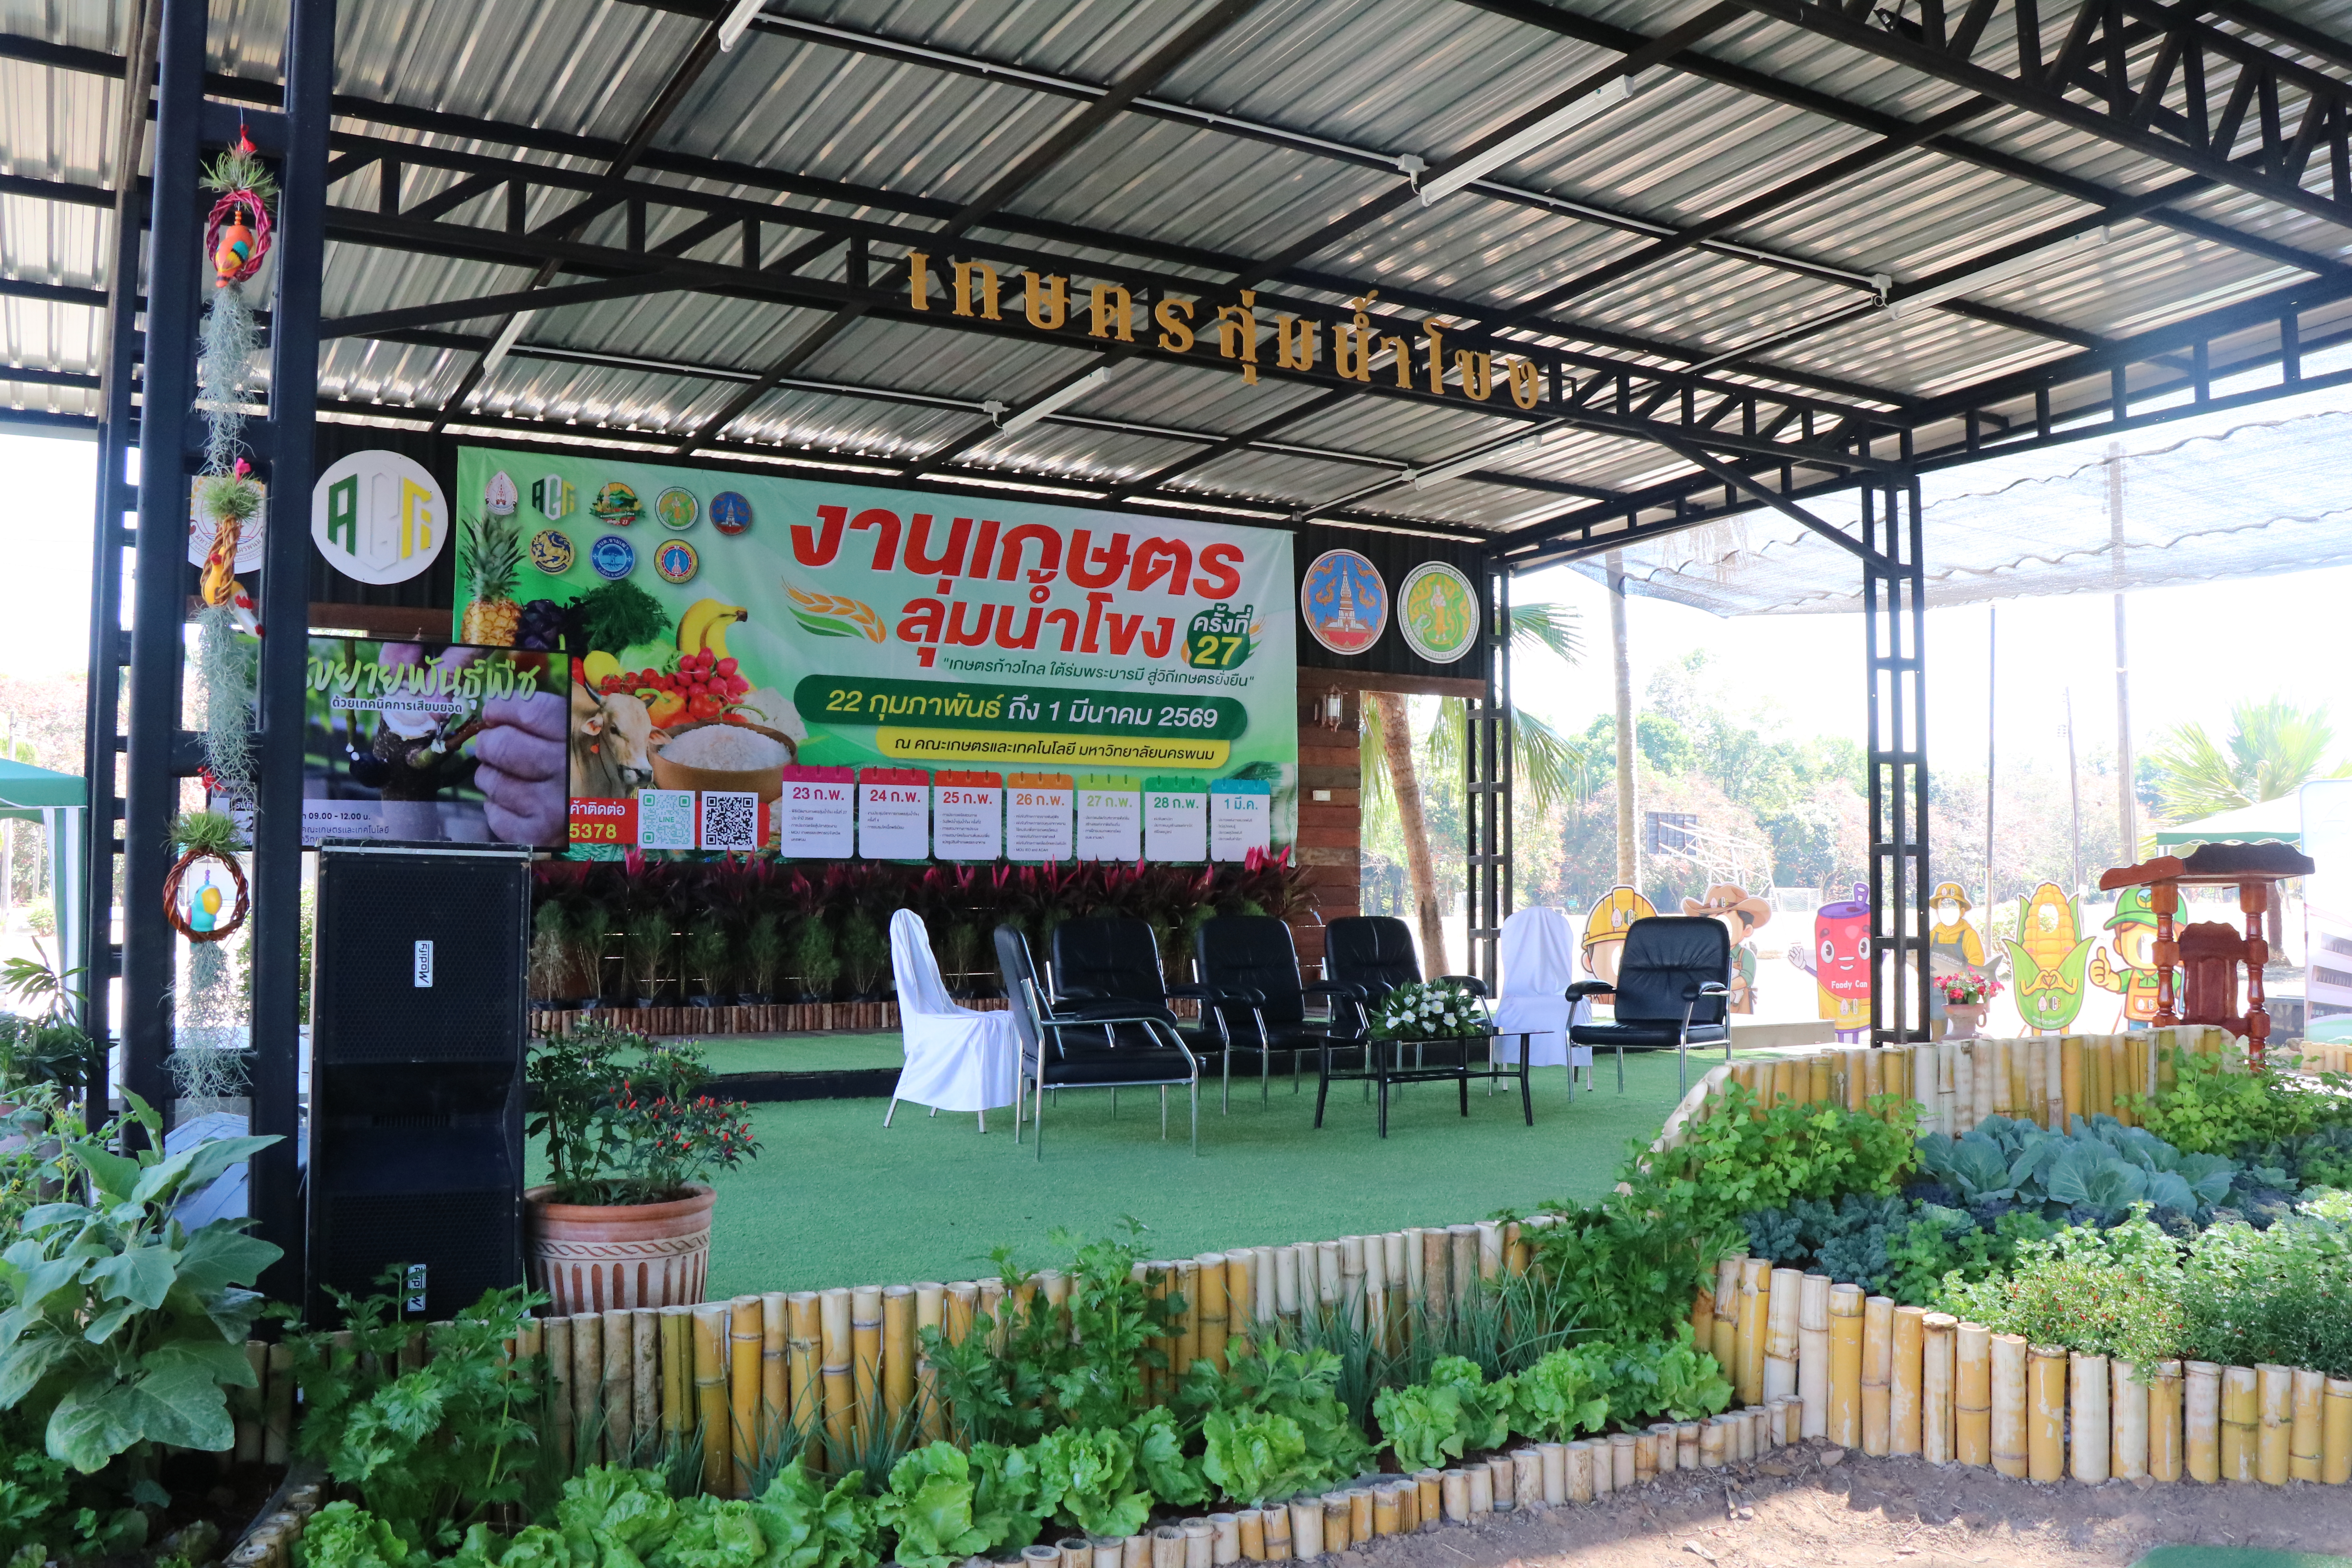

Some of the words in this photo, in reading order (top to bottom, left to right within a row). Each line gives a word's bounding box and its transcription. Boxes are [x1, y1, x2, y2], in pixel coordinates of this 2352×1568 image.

[907, 252, 1540, 410] เกษตรลุ่มน้ำโขง
[790, 504, 1244, 599] งานเกษตร
[896, 568, 1175, 667] ลุ่มน้ำโขง
[1193, 606, 1250, 634] ครั้งที่
[1402, 605, 1411, 633] MINISTRY
[1409, 633, 1415, 641] OF
[1415, 641, 1447, 658] AGRICULTURE
[1448, 649, 1458, 657] AND
[1458, 613, 1475, 652] COOPERATIVES
[1194, 635, 1243, 665] 27
[943, 657, 1045, 676] "เกษตรก้าวไกล
[1051, 661, 1143, 681] ใต้ร่มพระบารมี
[1148, 669, 1254, 687] สู่วิถีเกษตรยั่งยืน"
[333, 698, 462, 713] ด้วยเทคนิคการเสียบยอด
[826, 690, 863, 712] 22
[868, 693, 1004, 721] กุมภาพันธ์
[1008, 694, 1040, 720] ถึง
[1049, 701, 1060, 721] 1
[1068, 698, 1152, 726] มีนาคม
[1158, 706, 1218, 728] 2569
[895, 739, 911, 749] ณ
[915, 739, 1075, 755] คณะเกษตรและเทคโนโลยี
[1079, 744, 1214, 760] มหาวิทยาลัยนครพนม
[793, 787, 810, 799] 23
[814, 789, 844, 800] ก.พ.
[870, 789, 887, 801] 24
[891, 791, 920, 802] ก.พ.
[943, 791, 959, 803] 25
[964, 793, 992, 804] ก.พ.
[1016, 793, 1032, 805] 26
[1036, 795, 1064, 806] ก.พ.
[1087, 795, 1102, 807] 27
[1105, 797, 1132, 807] ก.พ.
[1154, 797, 1169, 808] 28
[1172, 799, 1199, 808] ก.พ.
[1224, 799, 1229, 809] 1
[1234, 796, 1258, 809] มี.ค.
[419, 944, 429, 983] Modify
[1831, 980, 1852, 990] Foody
